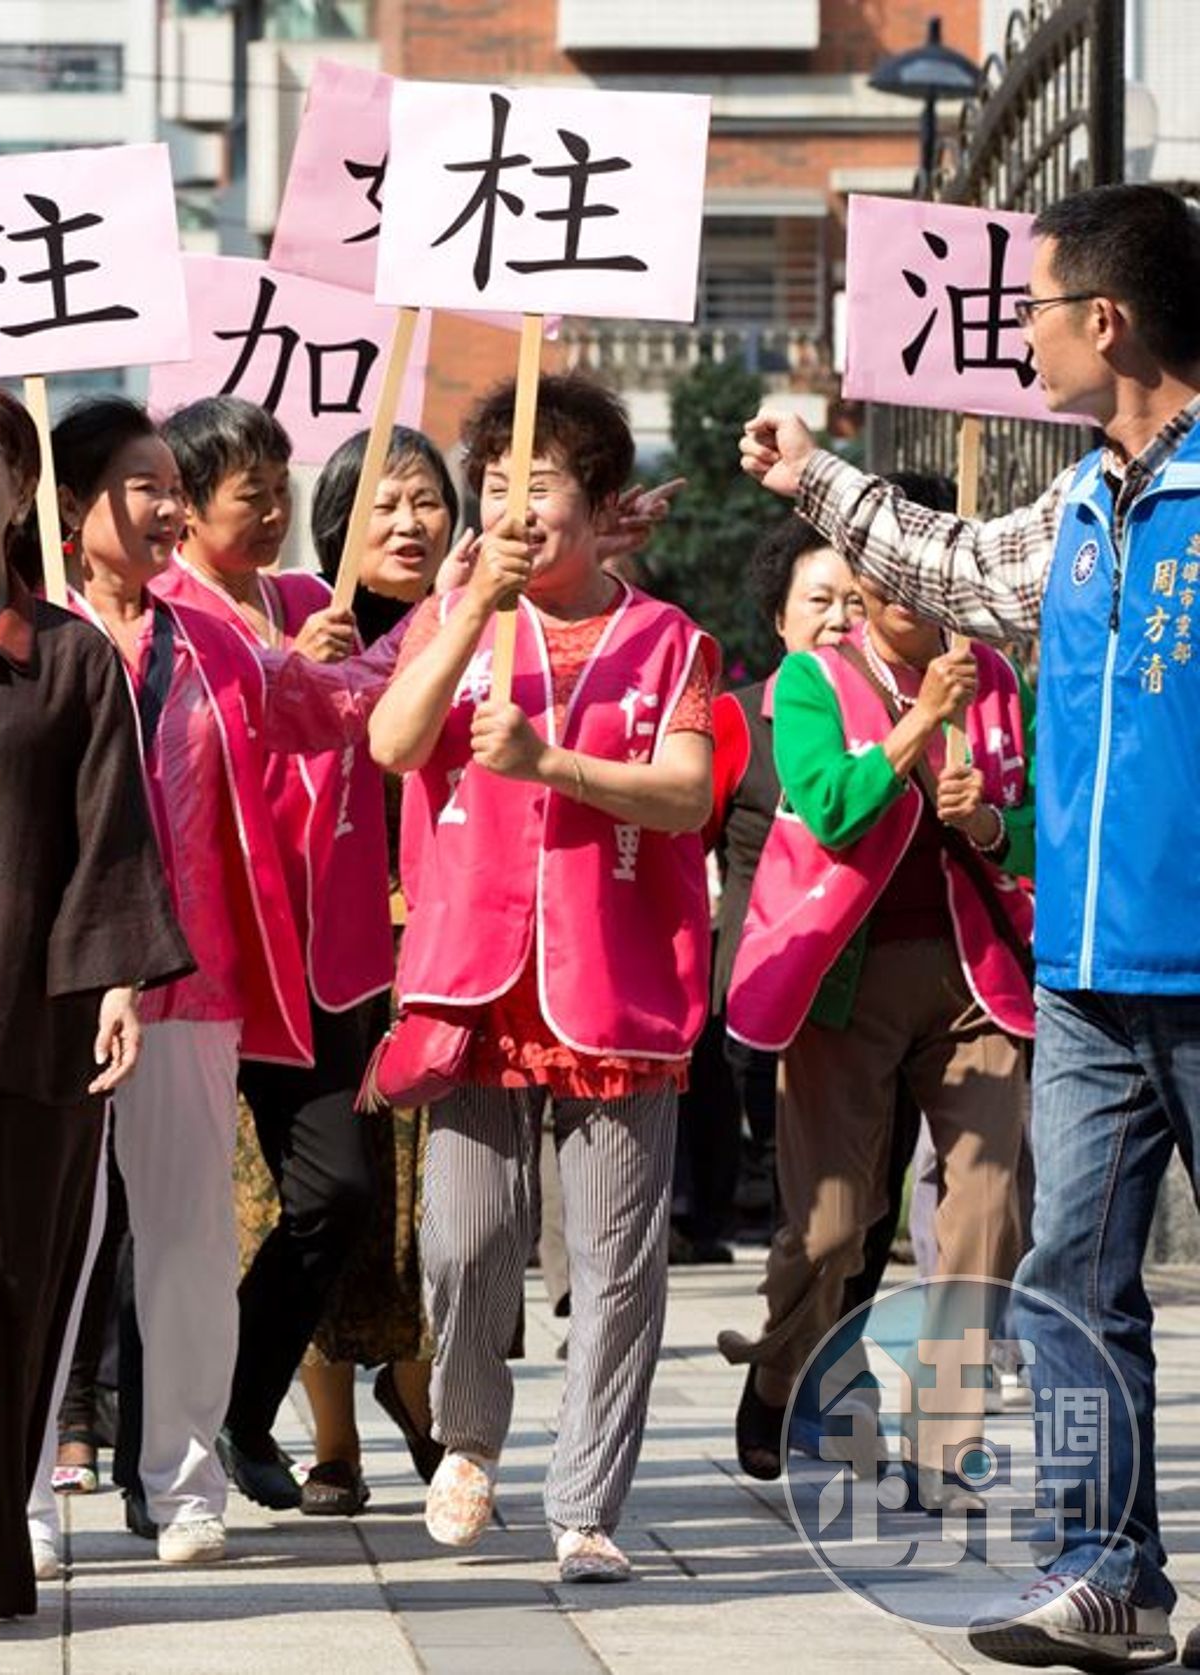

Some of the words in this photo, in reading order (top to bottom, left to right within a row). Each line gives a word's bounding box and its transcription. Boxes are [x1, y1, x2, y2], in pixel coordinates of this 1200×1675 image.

[431, 93, 648, 291] 柱
[215, 276, 379, 417] 加
[901, 222, 1036, 389] 油
